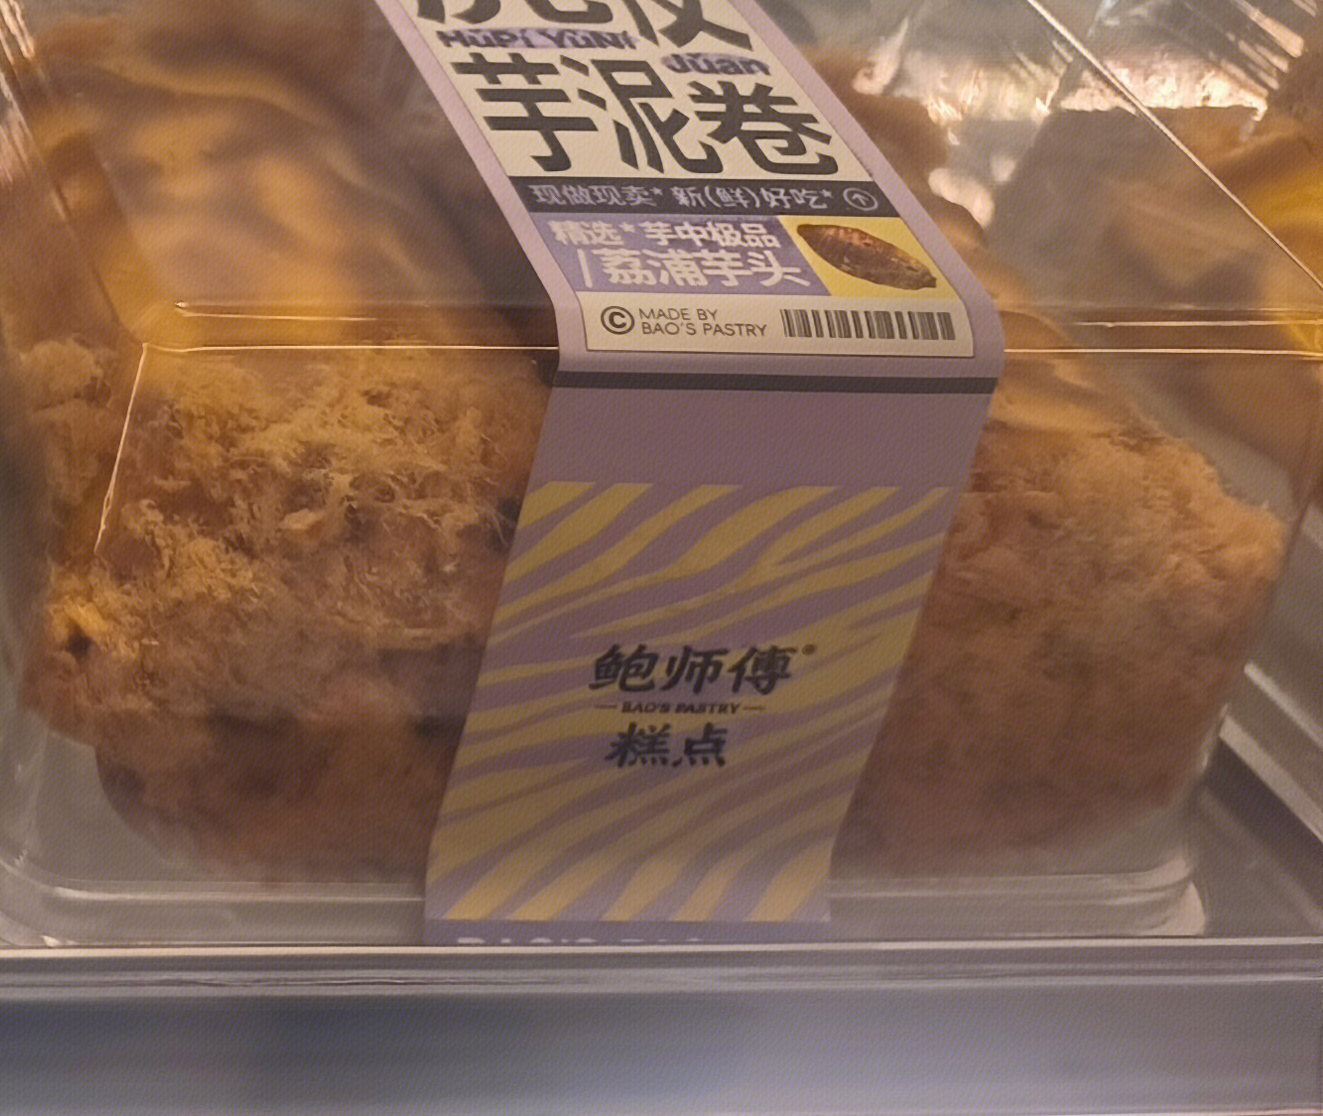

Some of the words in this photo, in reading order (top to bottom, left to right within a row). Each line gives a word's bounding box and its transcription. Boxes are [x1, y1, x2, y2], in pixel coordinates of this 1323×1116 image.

[451, 52, 839, 175] 芋泥卷
[639, 308, 691, 322] MADE
[696, 309, 718, 322] BY
[641, 322, 697, 337] BAO'S
[701, 323, 767, 338] PASTRY
[588, 643, 797, 696] 鲍师傅
[675, 702, 742, 715] PASTRY
[605, 722, 729, 768] 糕点
